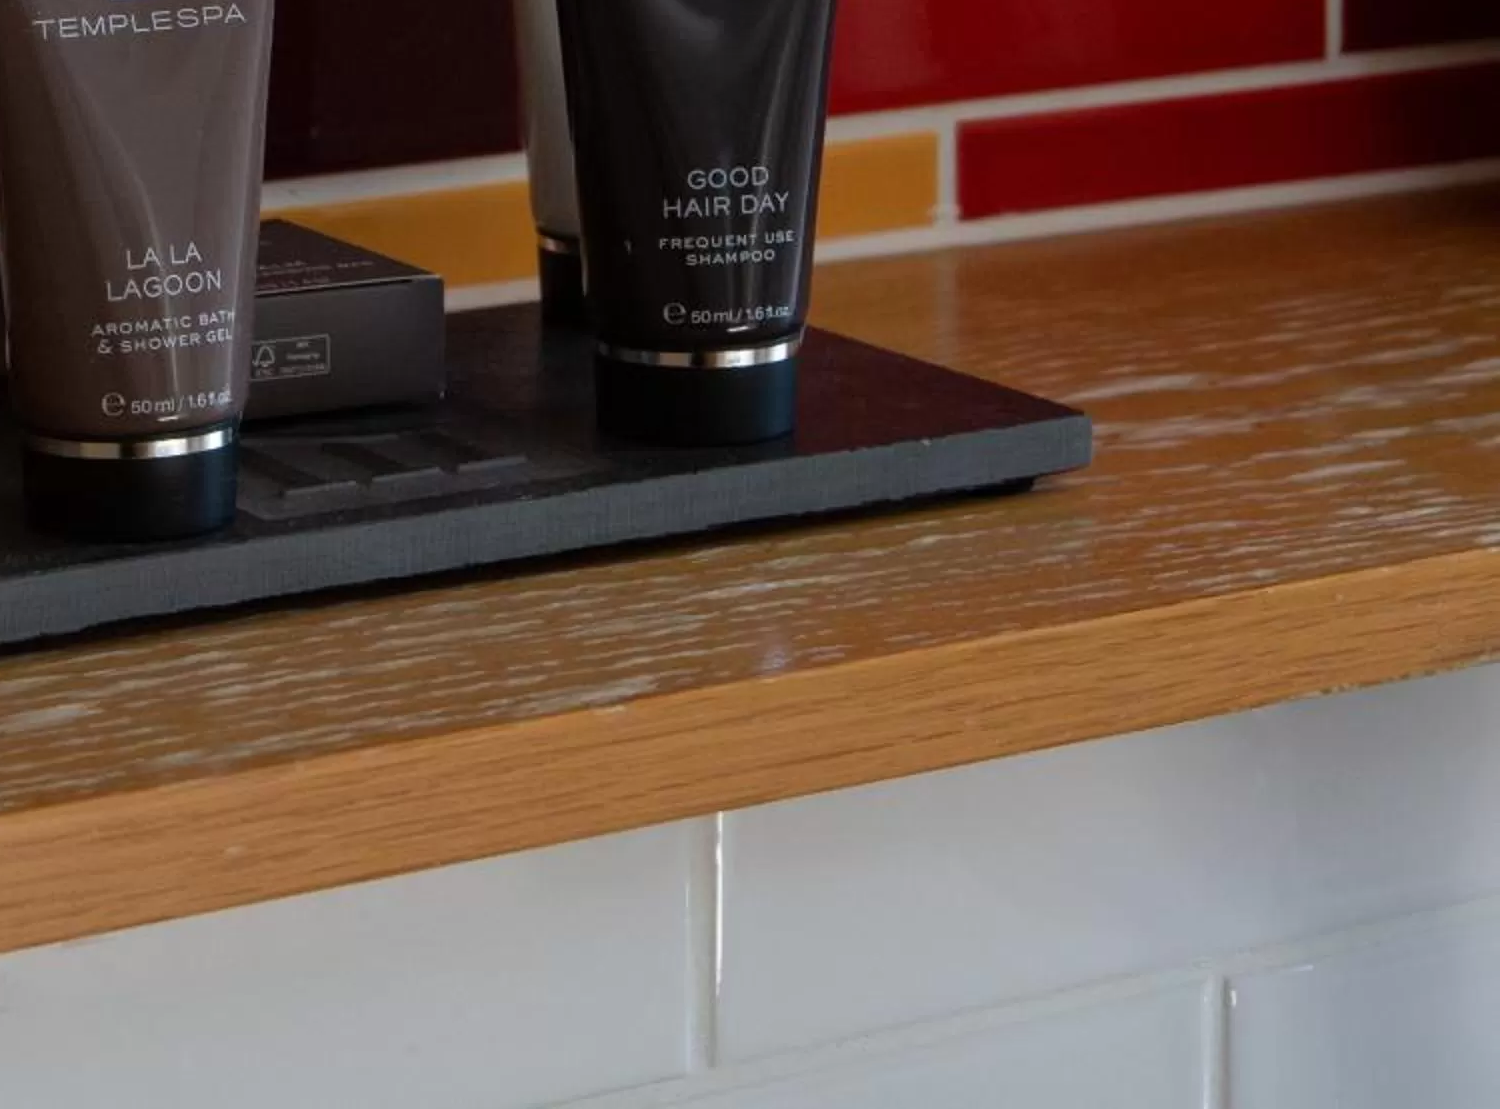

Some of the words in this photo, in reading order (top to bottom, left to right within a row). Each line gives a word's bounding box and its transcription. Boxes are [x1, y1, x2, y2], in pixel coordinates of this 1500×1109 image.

[32, 3, 247, 40] TEMPLESPA
[687, 166, 770, 190] GOOD
[663, 195, 731, 219] HAIR
[741, 191, 789, 215] DAY
[658, 232, 757, 250] FREQUENT
[765, 230, 796, 244] USE
[126, 246, 161, 270] LA
[170, 241, 202, 265] LA
[686, 249, 776, 267] SHAMPOO
[105, 267, 222, 302] LAGOON
[90, 314, 192, 337] AROMATIC
[199, 308, 236, 327] BATH
[97, 339, 113, 354] &
[120, 332, 201, 353] SHOWER
[206, 327, 233, 343] GEL
